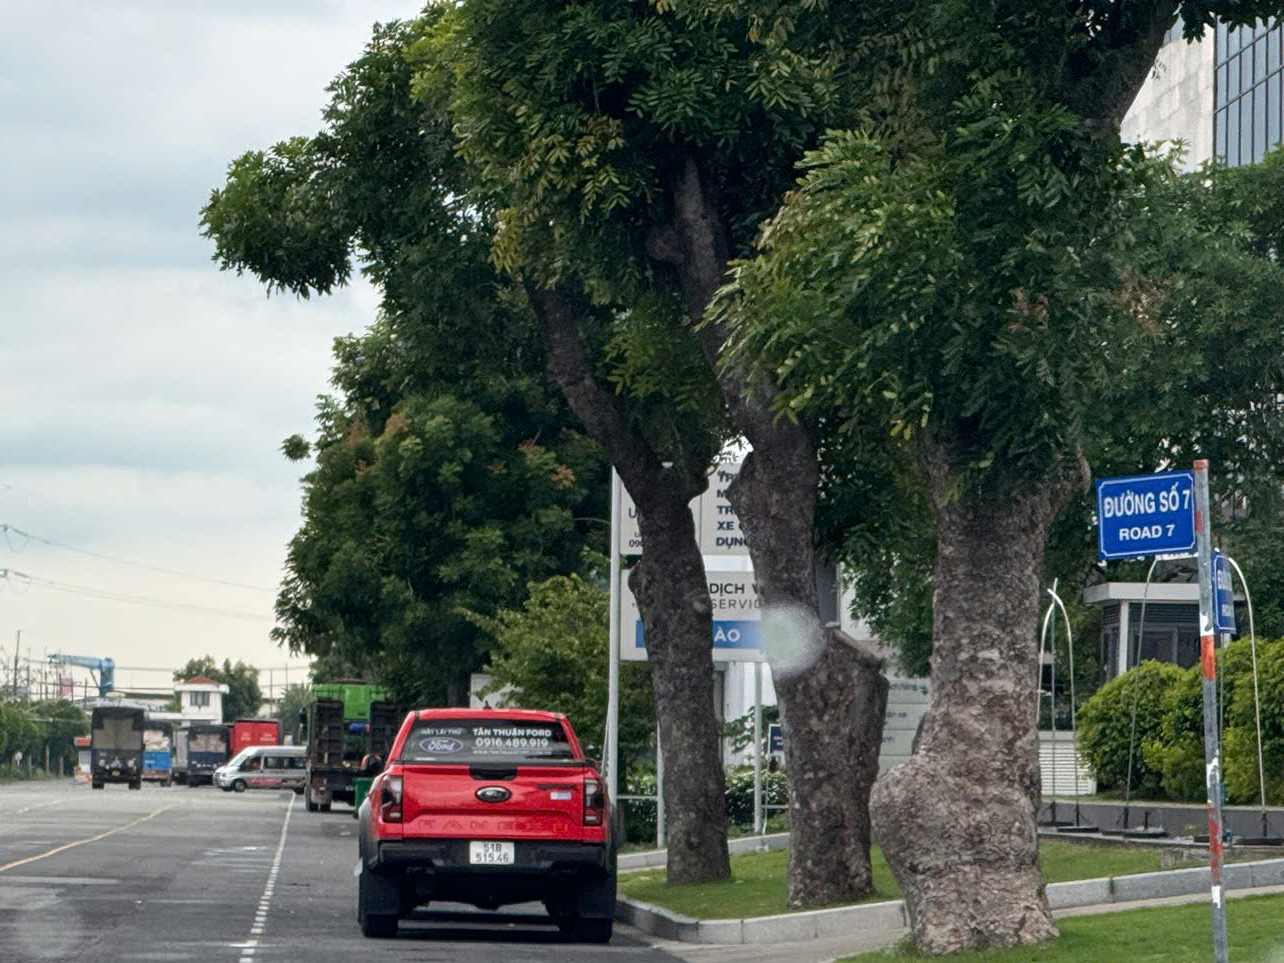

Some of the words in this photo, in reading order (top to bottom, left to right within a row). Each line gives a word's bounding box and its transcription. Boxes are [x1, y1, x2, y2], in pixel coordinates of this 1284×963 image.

[1104, 489, 1156, 518] ĐƯỜNG
[1159, 482, 1180, 513] SỐ
[1182, 489, 1191, 510] 7
[717, 521, 735, 530] XE
[1119, 526, 1162, 541] ROAD
[1167, 524, 1176, 537] 7
[709, 583, 745, 596] DỊCH
[473, 728, 491, 737] TÂN
[526, 728, 552, 737] FORD
